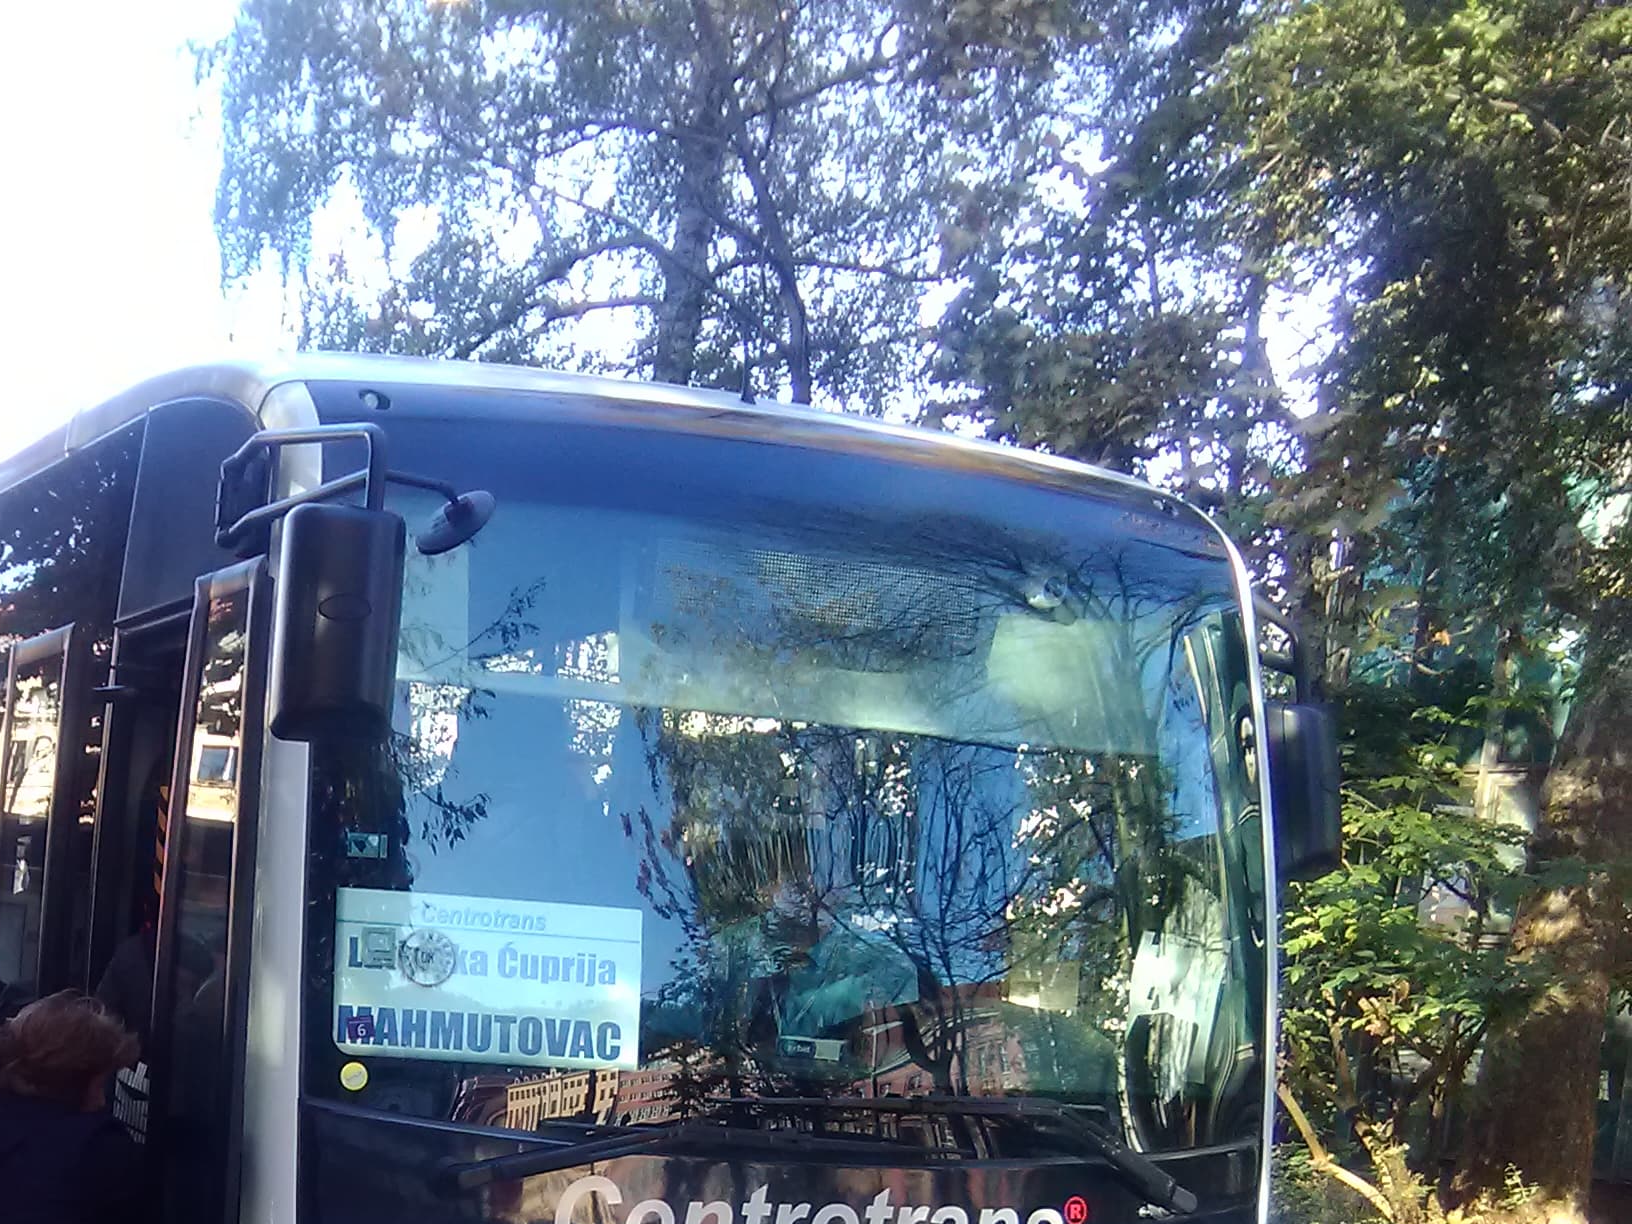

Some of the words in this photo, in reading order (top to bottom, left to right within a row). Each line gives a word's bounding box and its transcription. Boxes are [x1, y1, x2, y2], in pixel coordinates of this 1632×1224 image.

[421, 904, 547, 932] Centrotrans
[496, 941, 617, 987] Ćuprija
[337, 1004, 621, 1061] MAHMUTOVAC
